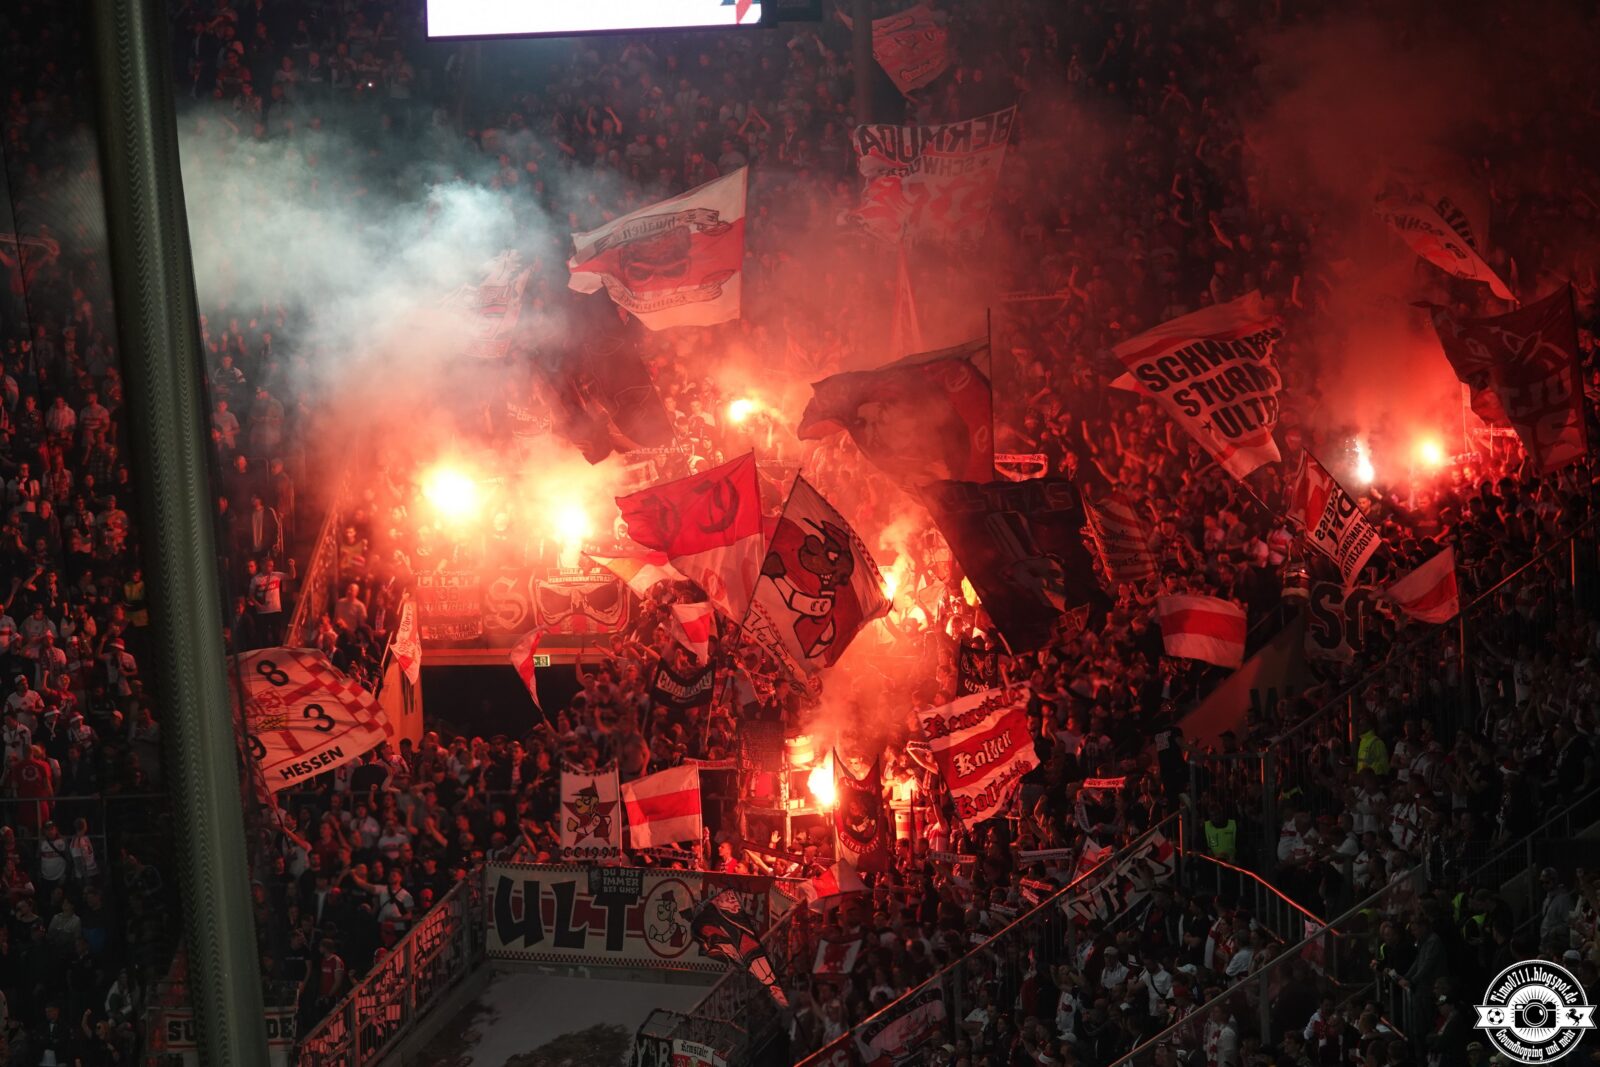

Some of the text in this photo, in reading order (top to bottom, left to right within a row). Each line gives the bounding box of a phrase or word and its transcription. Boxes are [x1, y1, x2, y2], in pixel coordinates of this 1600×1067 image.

[1172, 362, 1279, 417] STURM
[256, 659, 290, 687] 8
[303, 703, 336, 732] 3
[279, 745, 345, 781] HESSEN
[602, 877, 640, 888] IMMER
[603, 868, 640, 878] DU BIST
[602, 886, 617, 895] BEI
